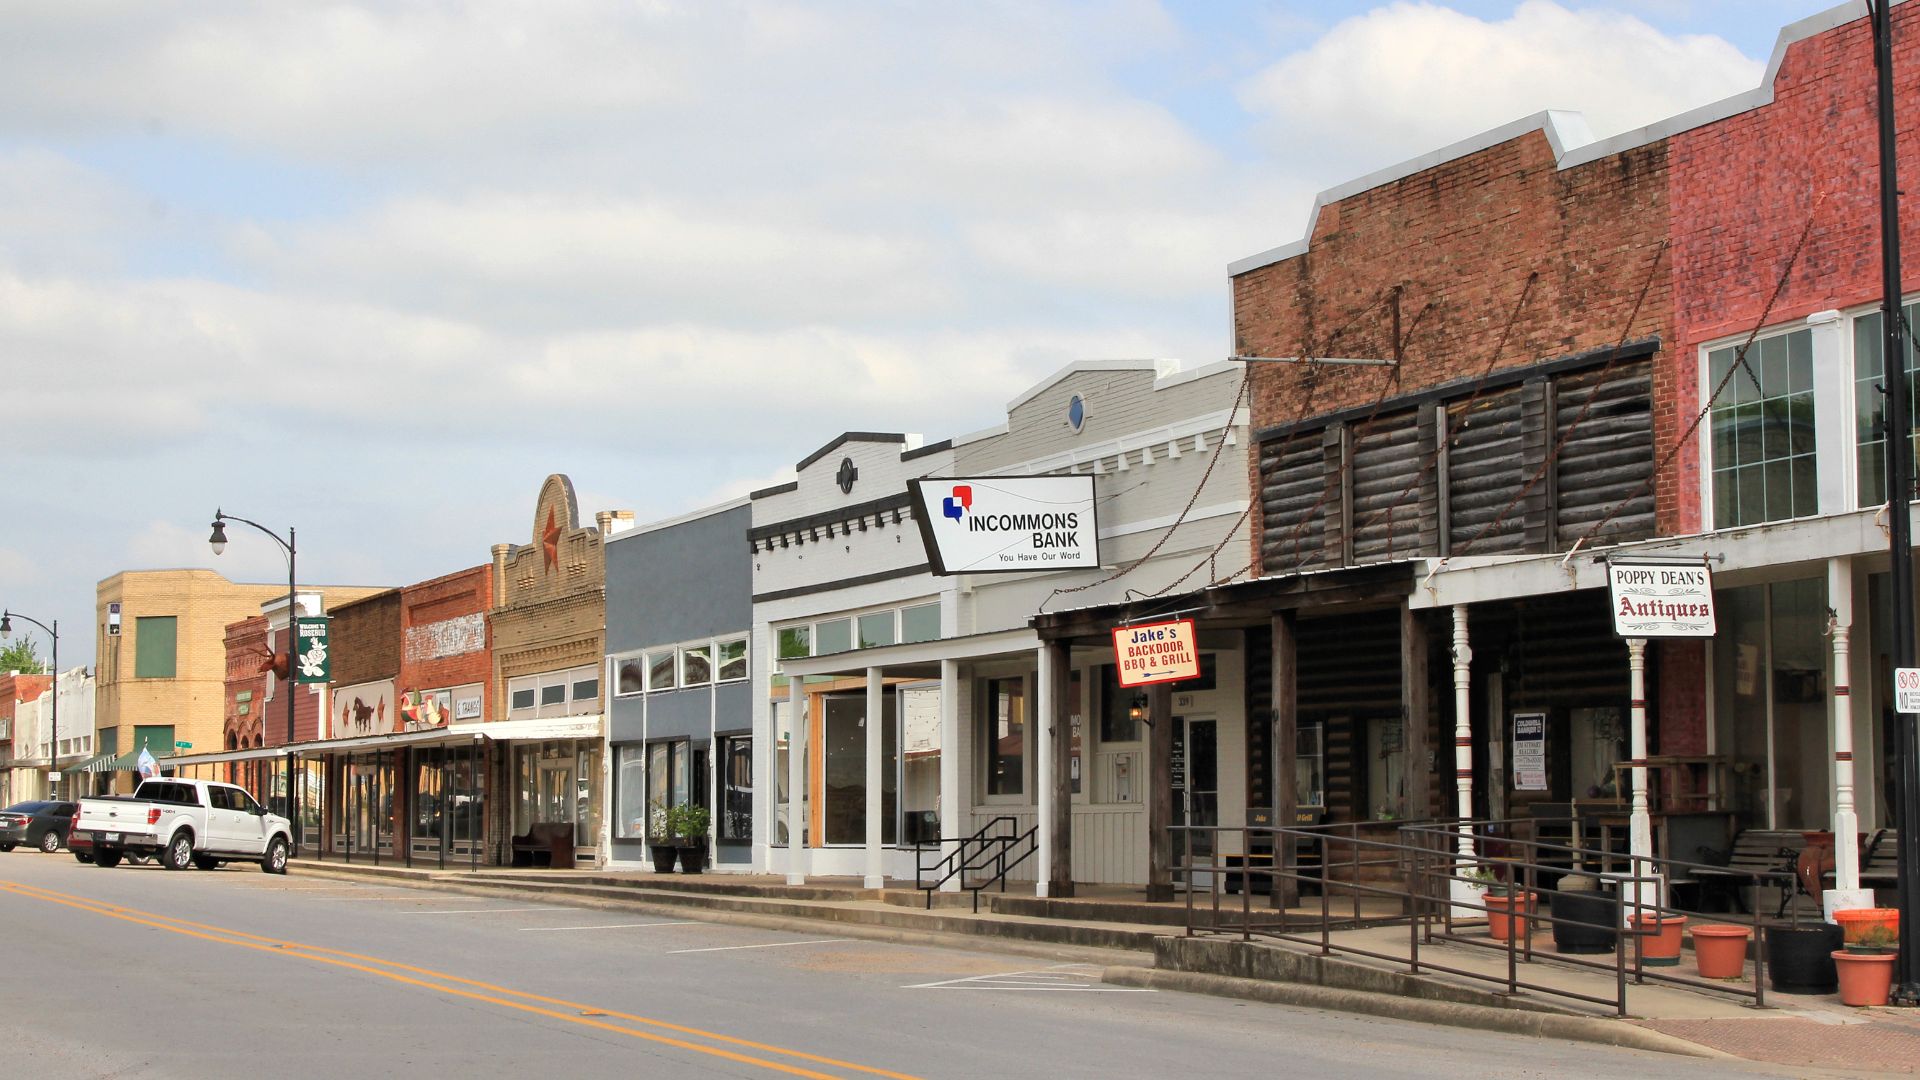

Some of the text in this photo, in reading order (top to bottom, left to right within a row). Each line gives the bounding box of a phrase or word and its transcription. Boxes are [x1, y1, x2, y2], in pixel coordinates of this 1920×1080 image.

[969, 512, 1078, 532] INCOMMONS
[1033, 531, 1079, 548] BANK
[999, 551, 1080, 562] You Have Our Word
[1616, 570, 1704, 585] POPPY DEAN'S
[1619, 597, 1709, 621] Antiques
[1131, 627, 1177, 643] Jake's
[1128, 640, 1184, 657] BACKDOOR
[1124, 652, 1192, 670] BBQ & GRILL
[1899, 692, 1908, 709] NO
